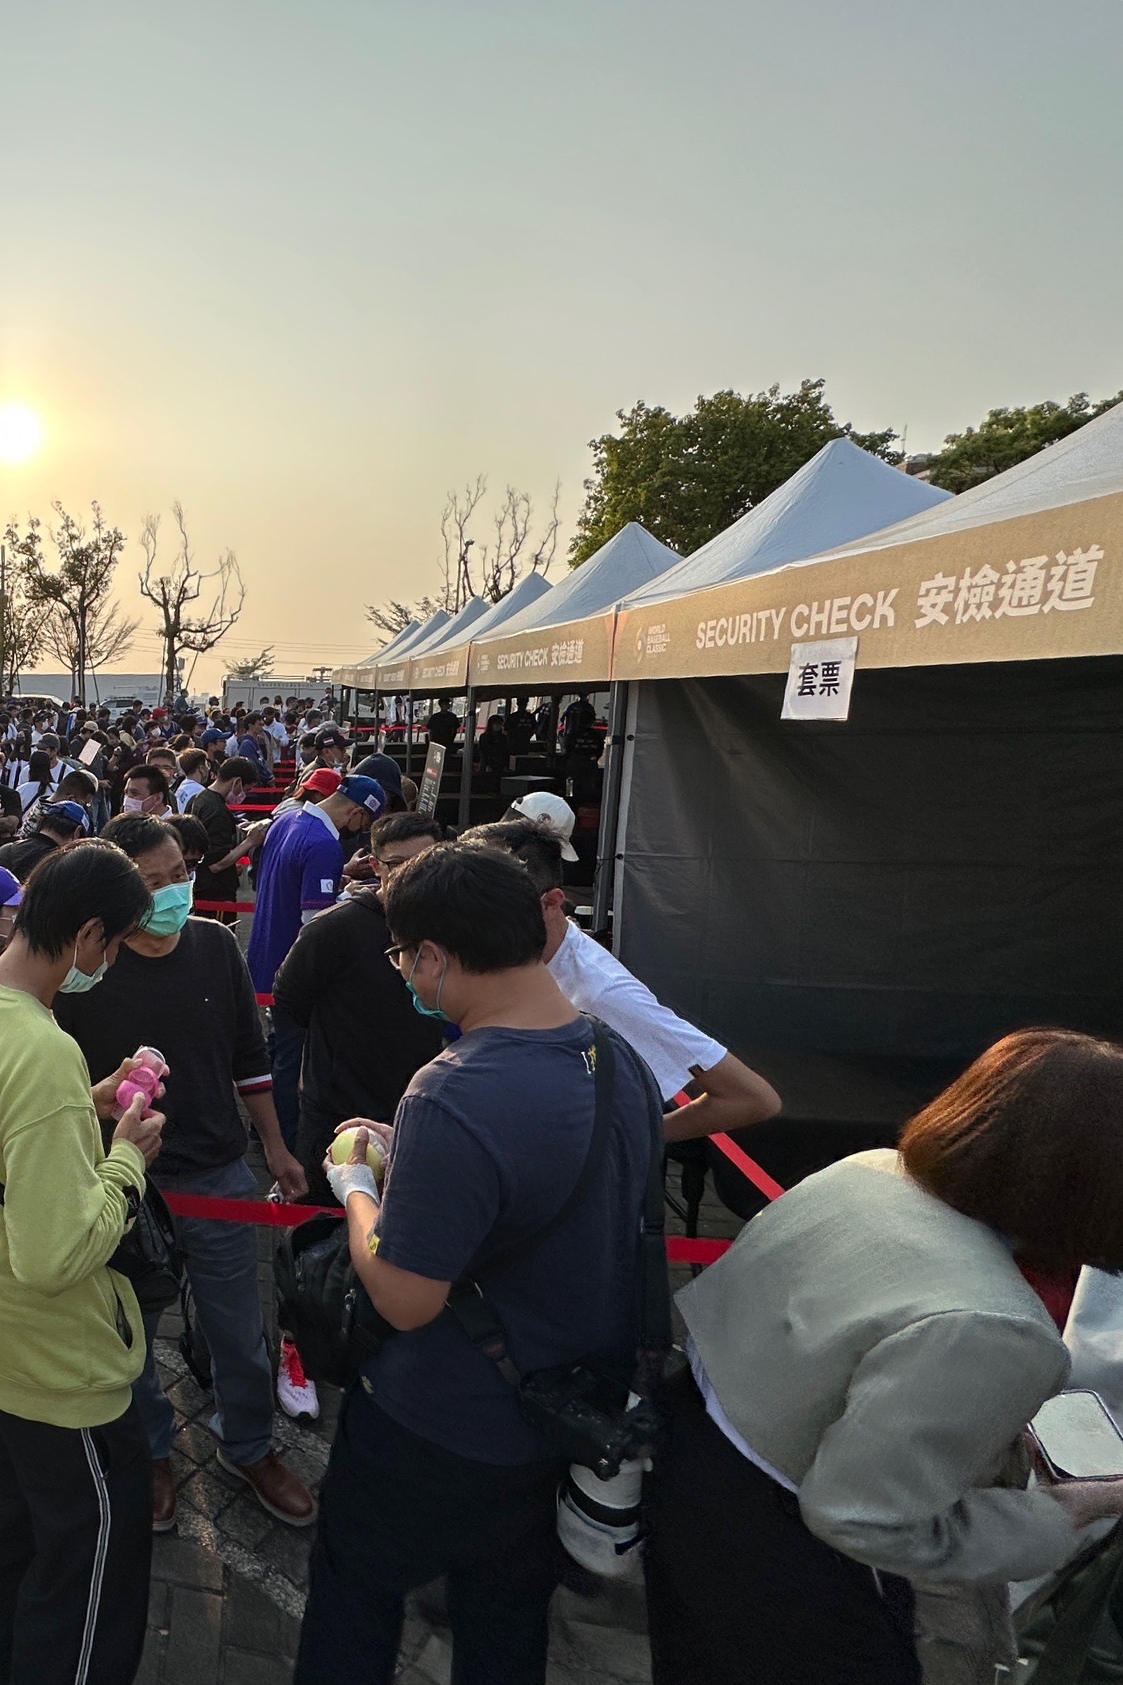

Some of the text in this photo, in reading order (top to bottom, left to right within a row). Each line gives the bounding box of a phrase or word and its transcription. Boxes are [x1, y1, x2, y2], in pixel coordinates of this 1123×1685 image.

[695, 544, 1106, 650] SECURITY CHECK 安檢通道
[497, 650, 525, 670] SECURITY
[524, 647, 550, 667] CHECK
[796, 660, 841, 697] 套票
